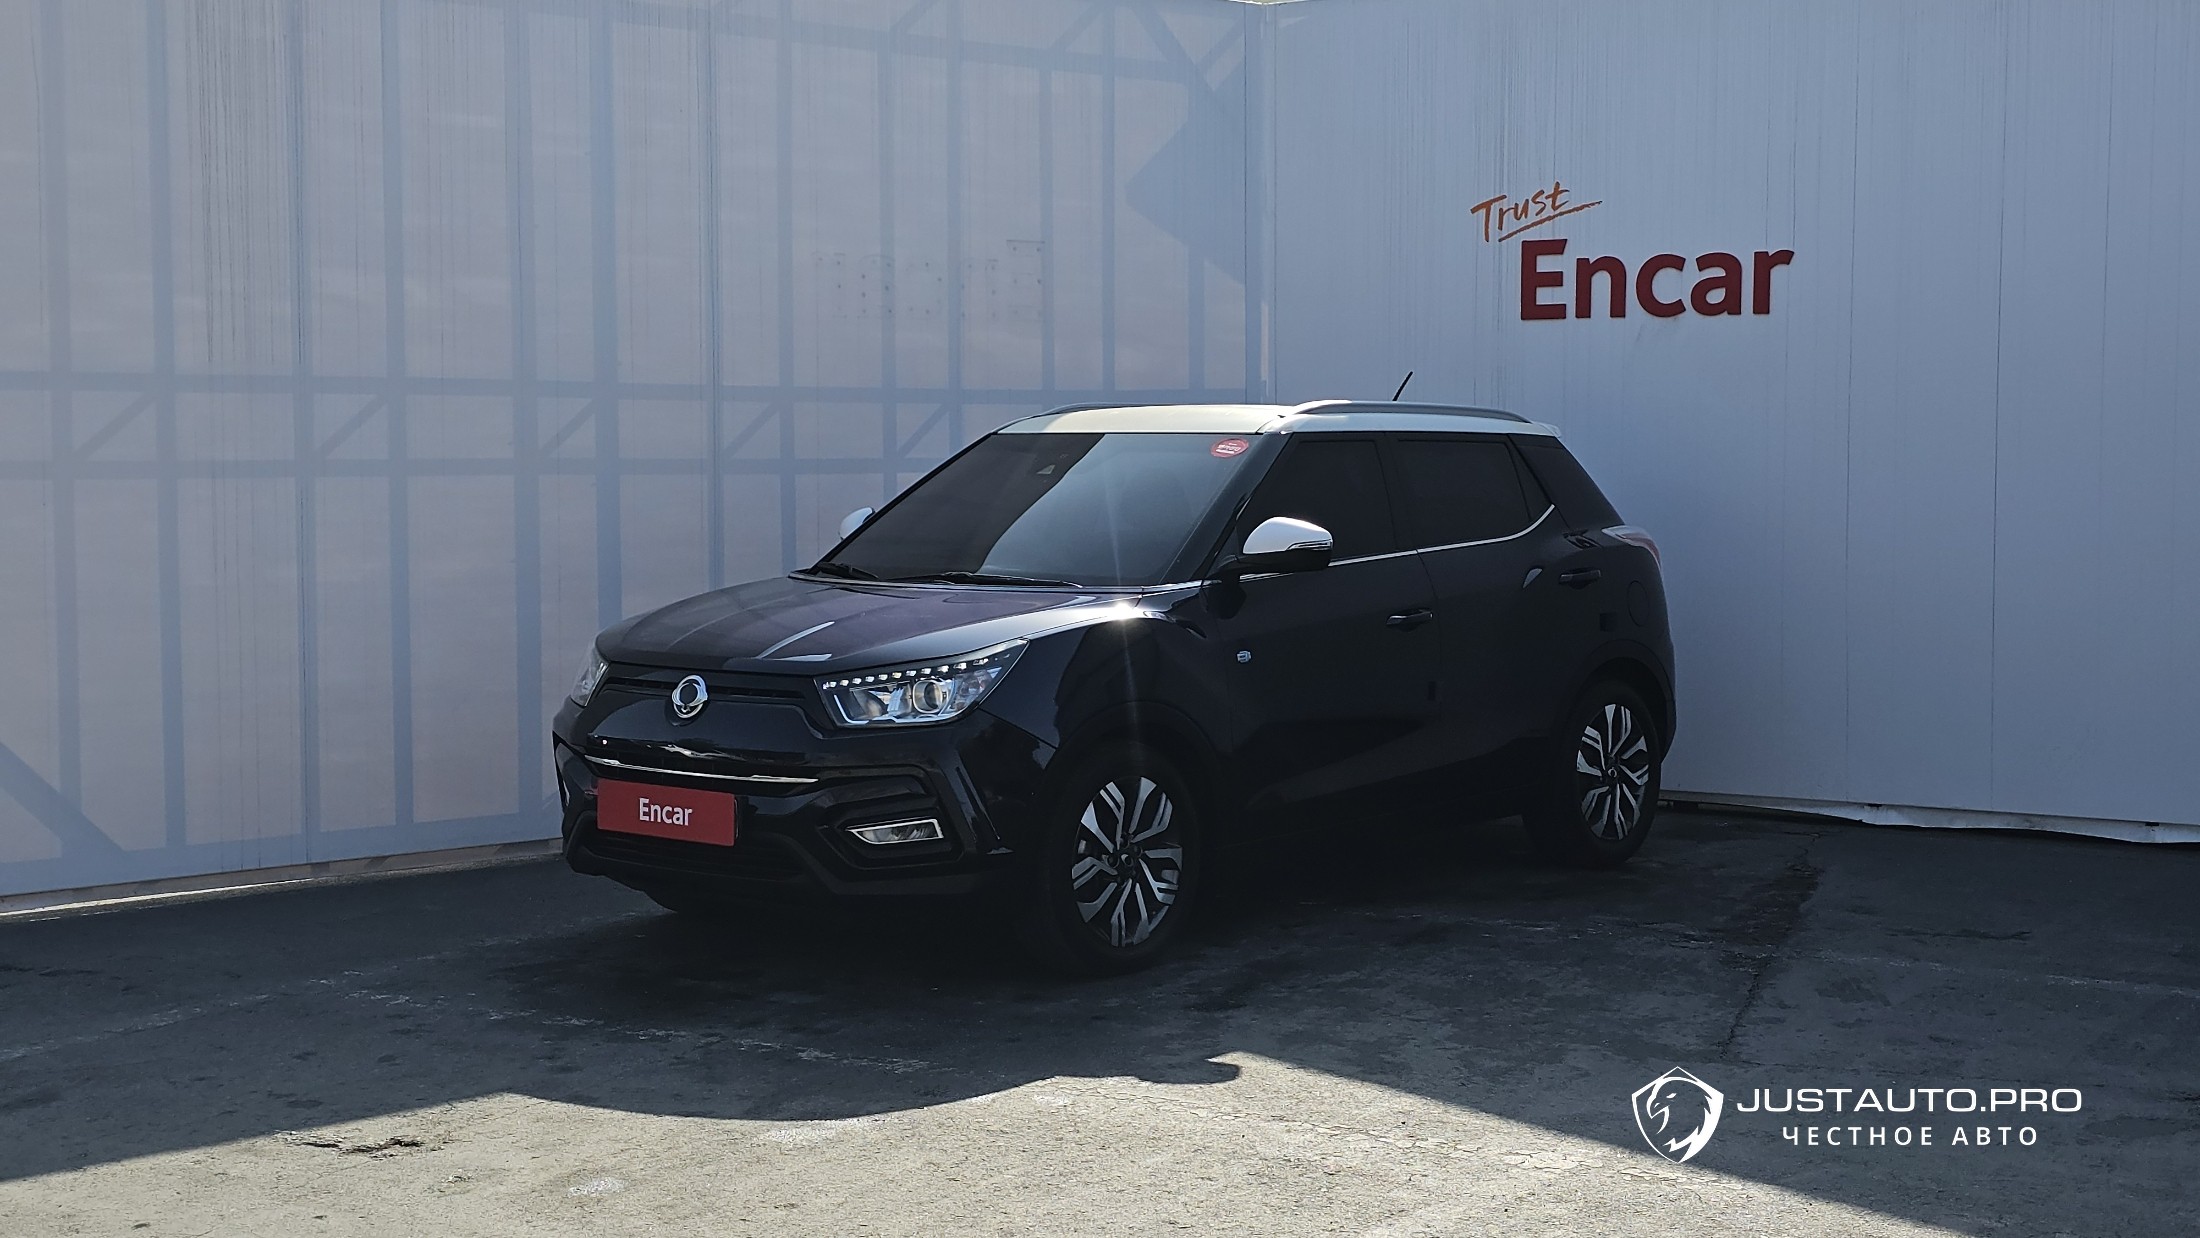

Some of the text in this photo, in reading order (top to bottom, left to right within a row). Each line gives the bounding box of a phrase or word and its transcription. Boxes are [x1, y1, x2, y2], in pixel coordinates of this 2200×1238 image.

[1471, 181, 1570, 242] Trust
[1520, 238, 1794, 320] Encar
[638, 797, 693, 826] Encar
